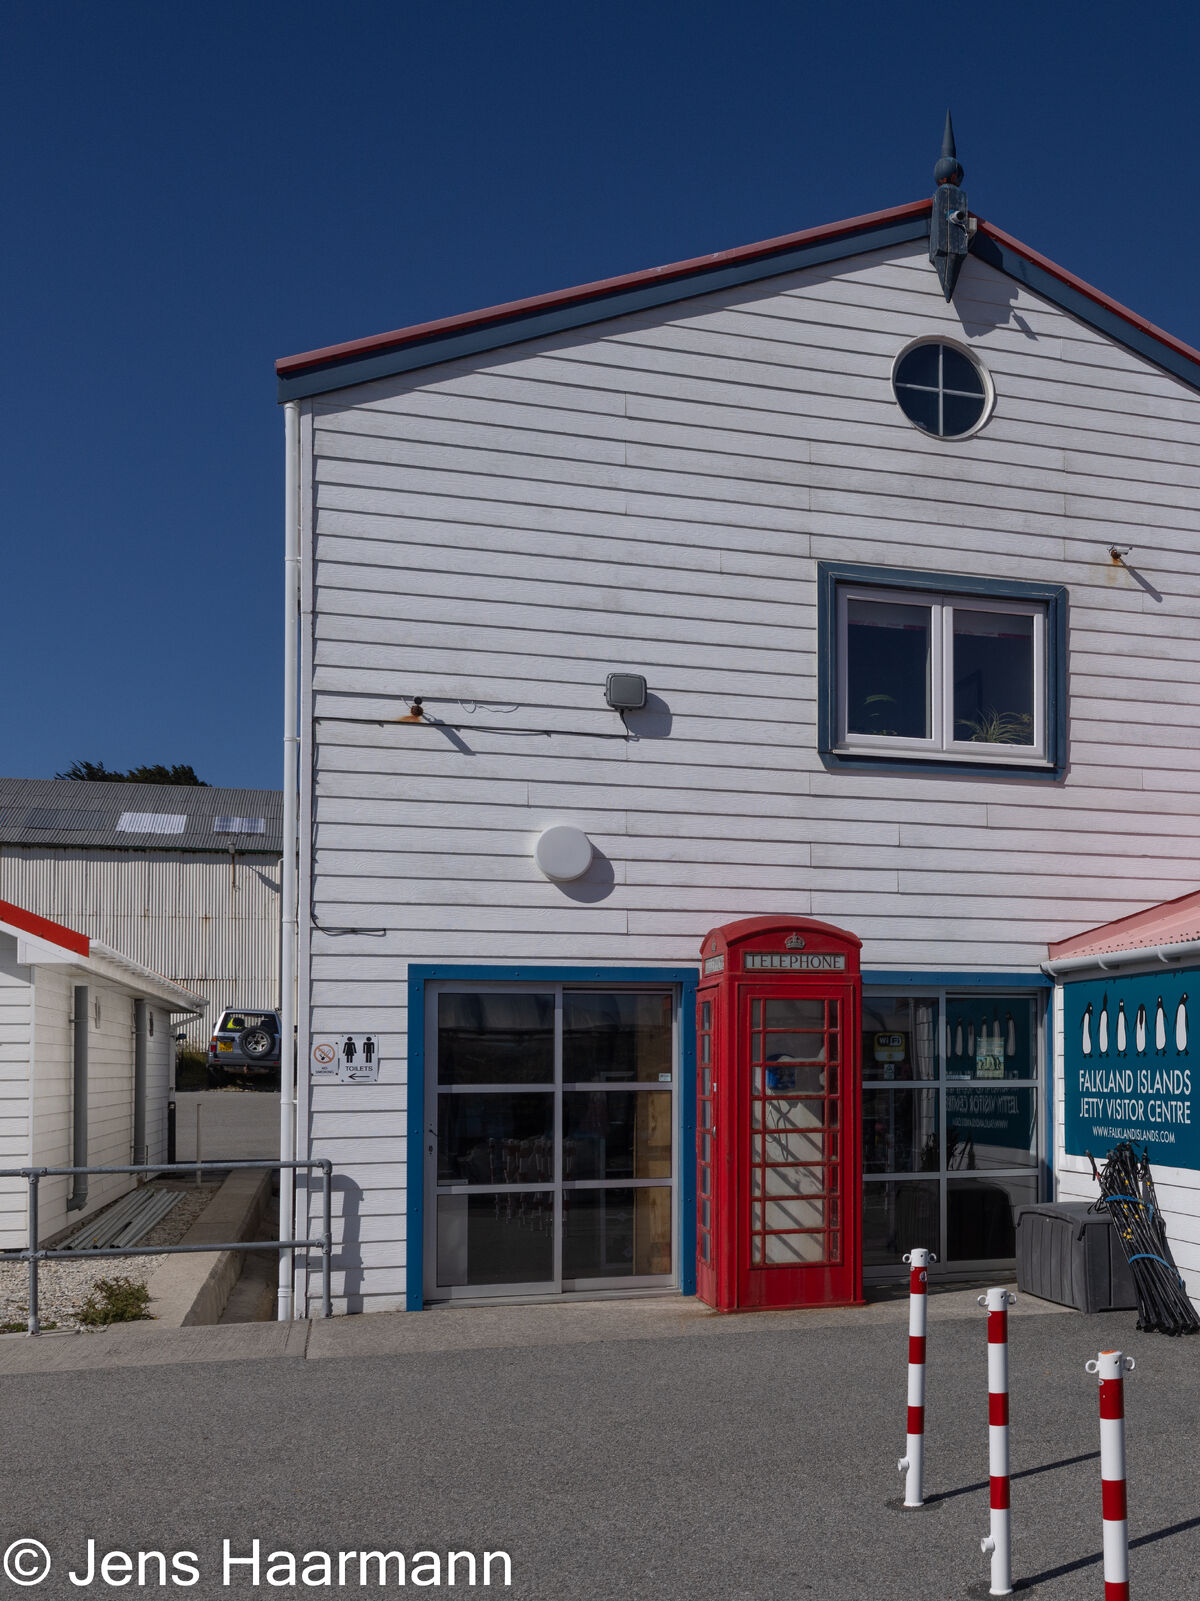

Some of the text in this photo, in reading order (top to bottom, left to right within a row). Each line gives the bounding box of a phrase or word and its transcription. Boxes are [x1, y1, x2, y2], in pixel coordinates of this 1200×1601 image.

[750, 954, 841, 969] TELEPHONE
[1079, 1069, 1191, 1095] FALKLAND ISLANDS
[1079, 1098, 1191, 1124] JETTY VISITOR CENTRE
[1092, 1126, 1175, 1143] WWW.FALKLANDISLANDS.COM
